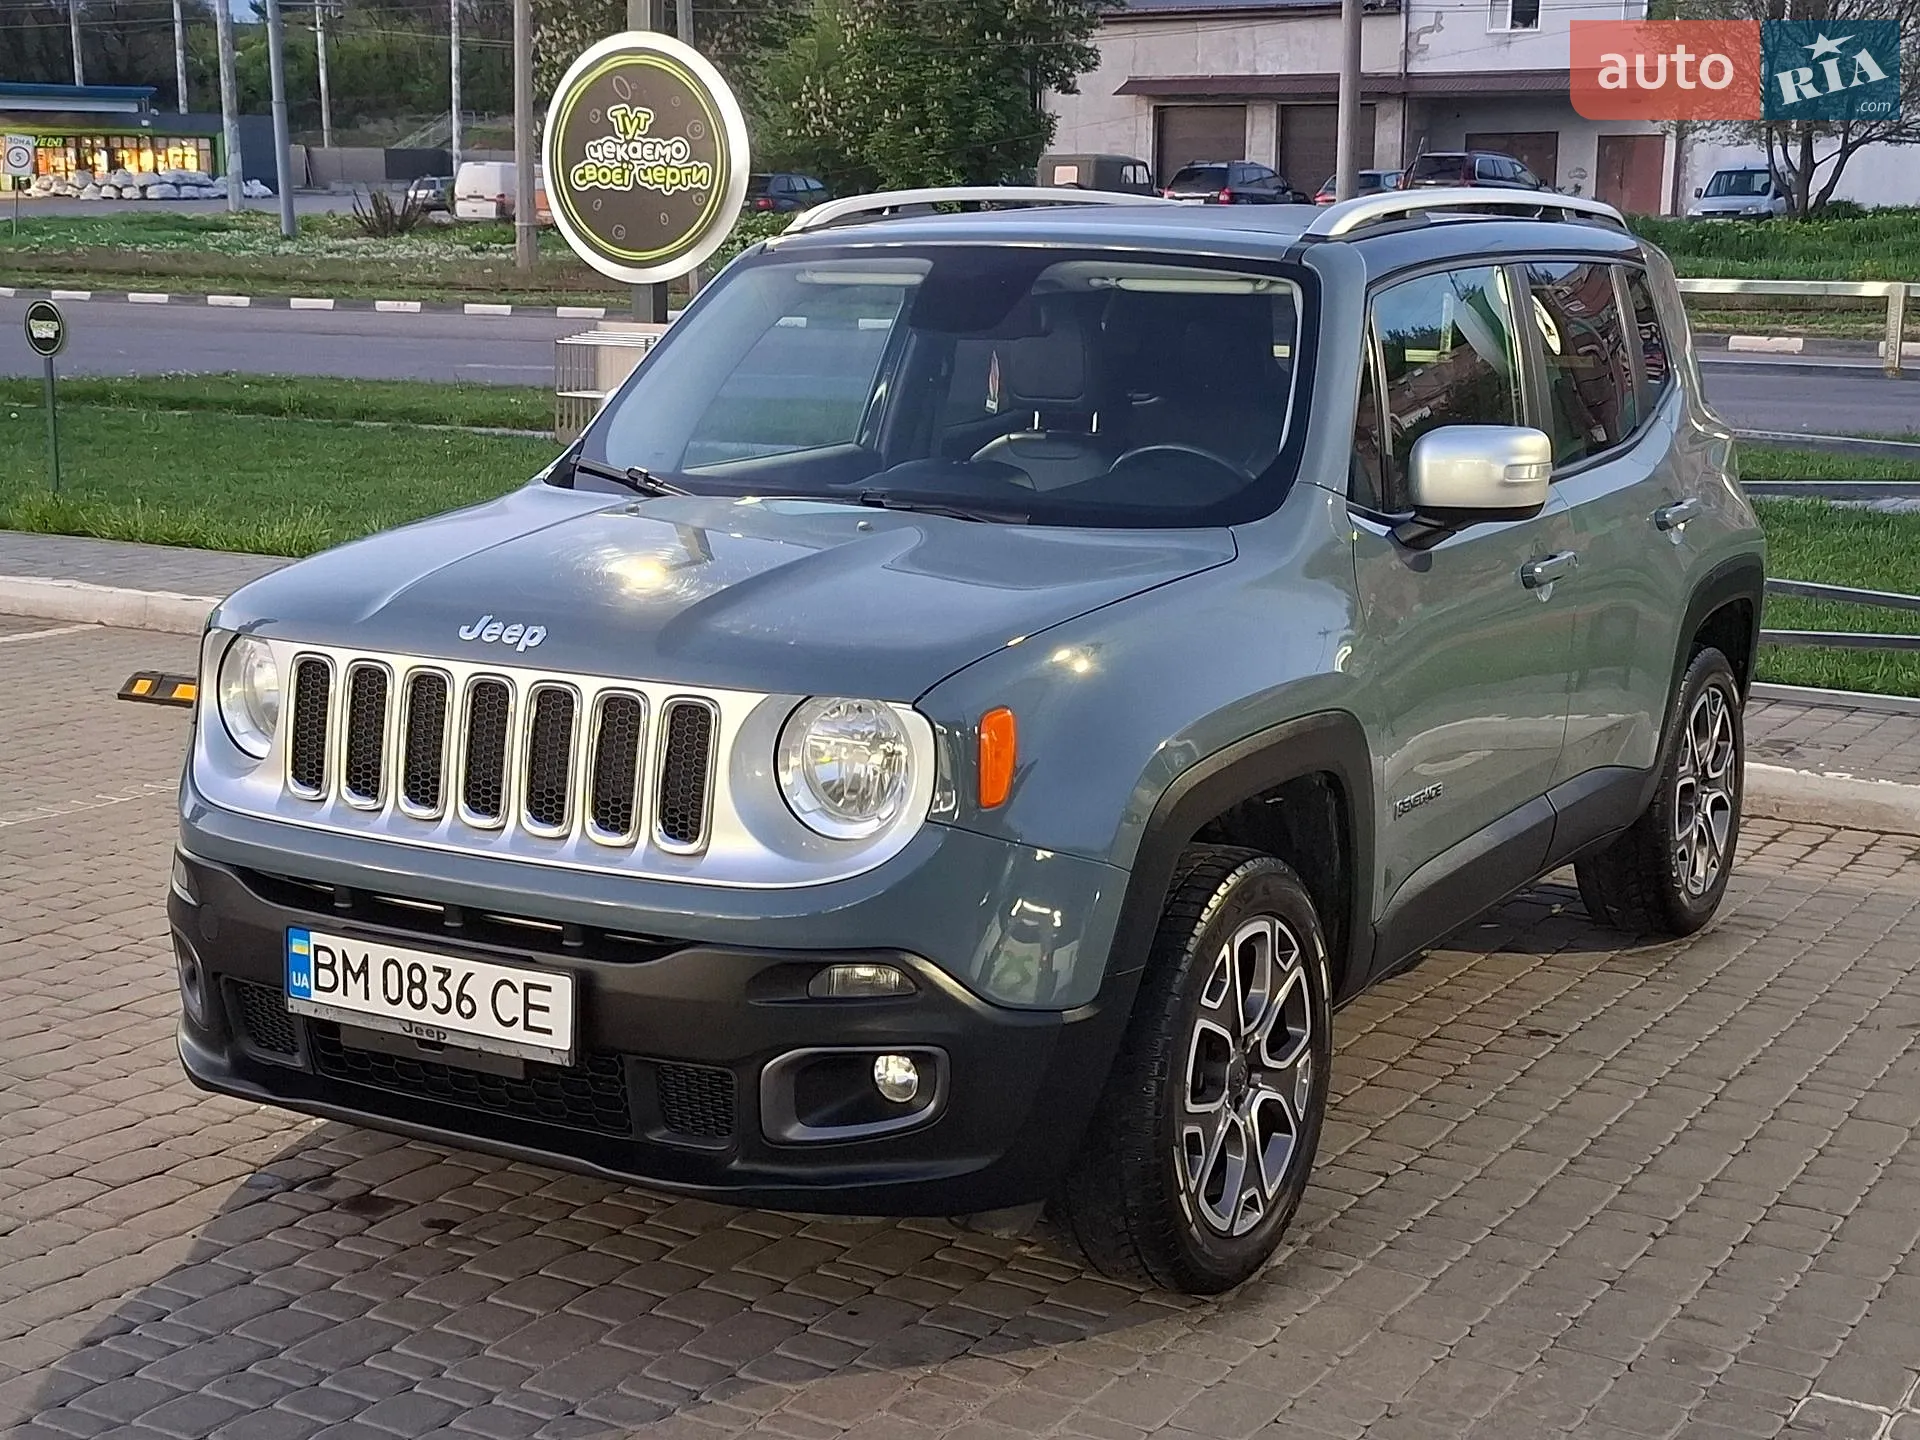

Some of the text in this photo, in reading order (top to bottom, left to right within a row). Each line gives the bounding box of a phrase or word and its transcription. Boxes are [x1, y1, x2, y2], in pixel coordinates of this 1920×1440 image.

[609, 106, 653, 142] Тут
[8, 136, 31, 145] ЗОНА
[587, 138, 688, 164] чекаємо
[15, 152, 22, 162] 5
[573, 162, 709, 192] своєї черги
[459, 614, 547, 652] Jeep
[292, 971, 309, 989] UA
[313, 943, 553, 1036] BM 0836 CE
[402, 1021, 447, 1040] Jeep
